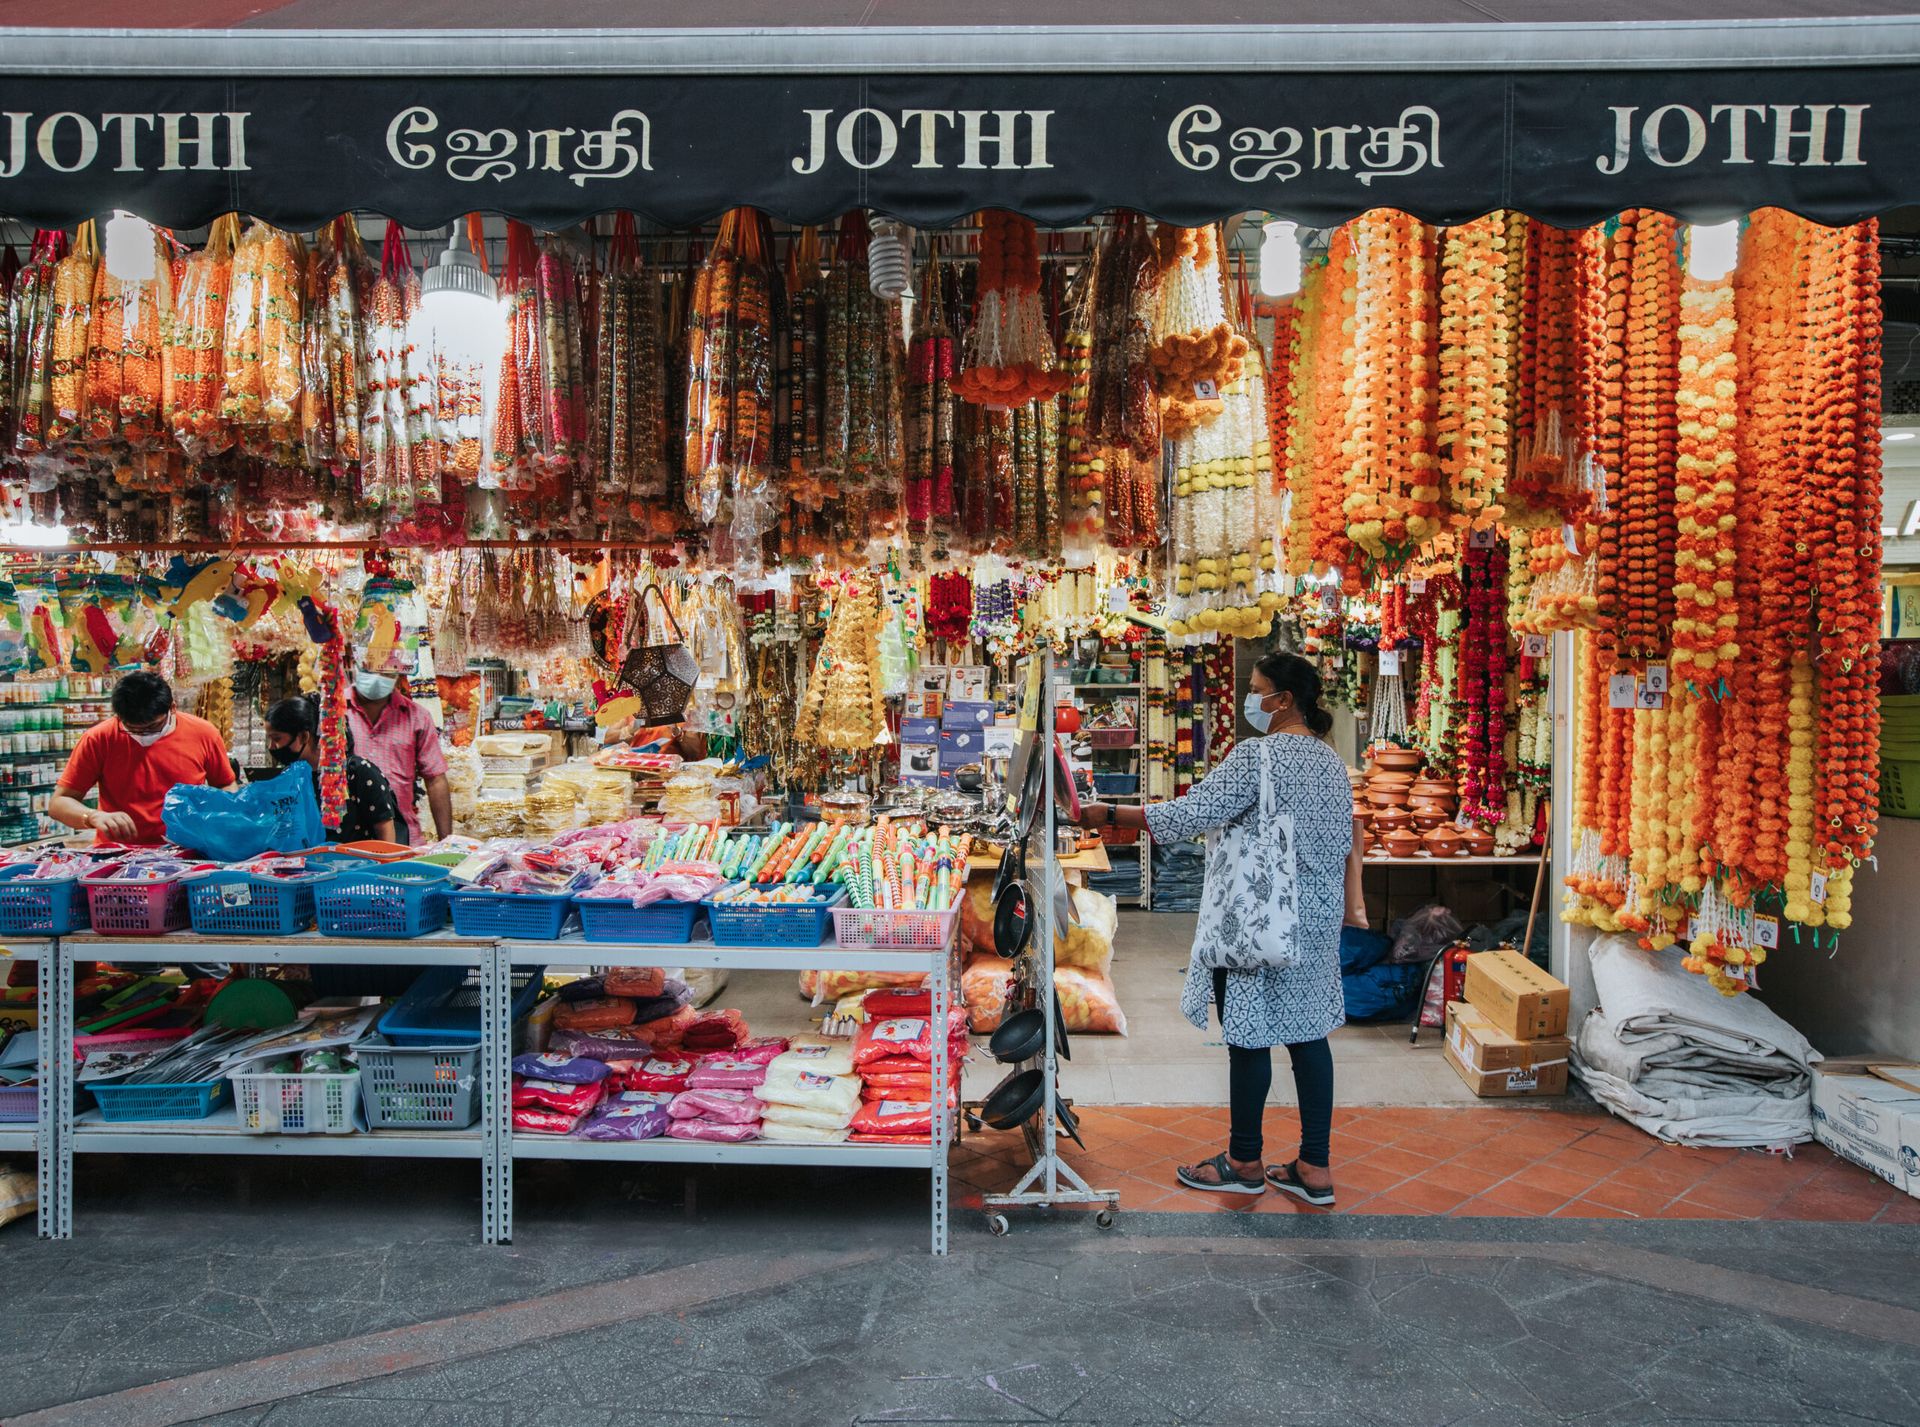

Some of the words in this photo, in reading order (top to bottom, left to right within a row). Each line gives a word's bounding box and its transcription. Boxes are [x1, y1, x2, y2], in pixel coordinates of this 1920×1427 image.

[0, 111, 252, 178] JOTHI
[385, 106, 654, 187] ஜோதி
[791, 108, 1056, 175] JOTHI
[1167, 104, 1445, 187] ஜோதி
[1595, 104, 1871, 175] JOTHI
